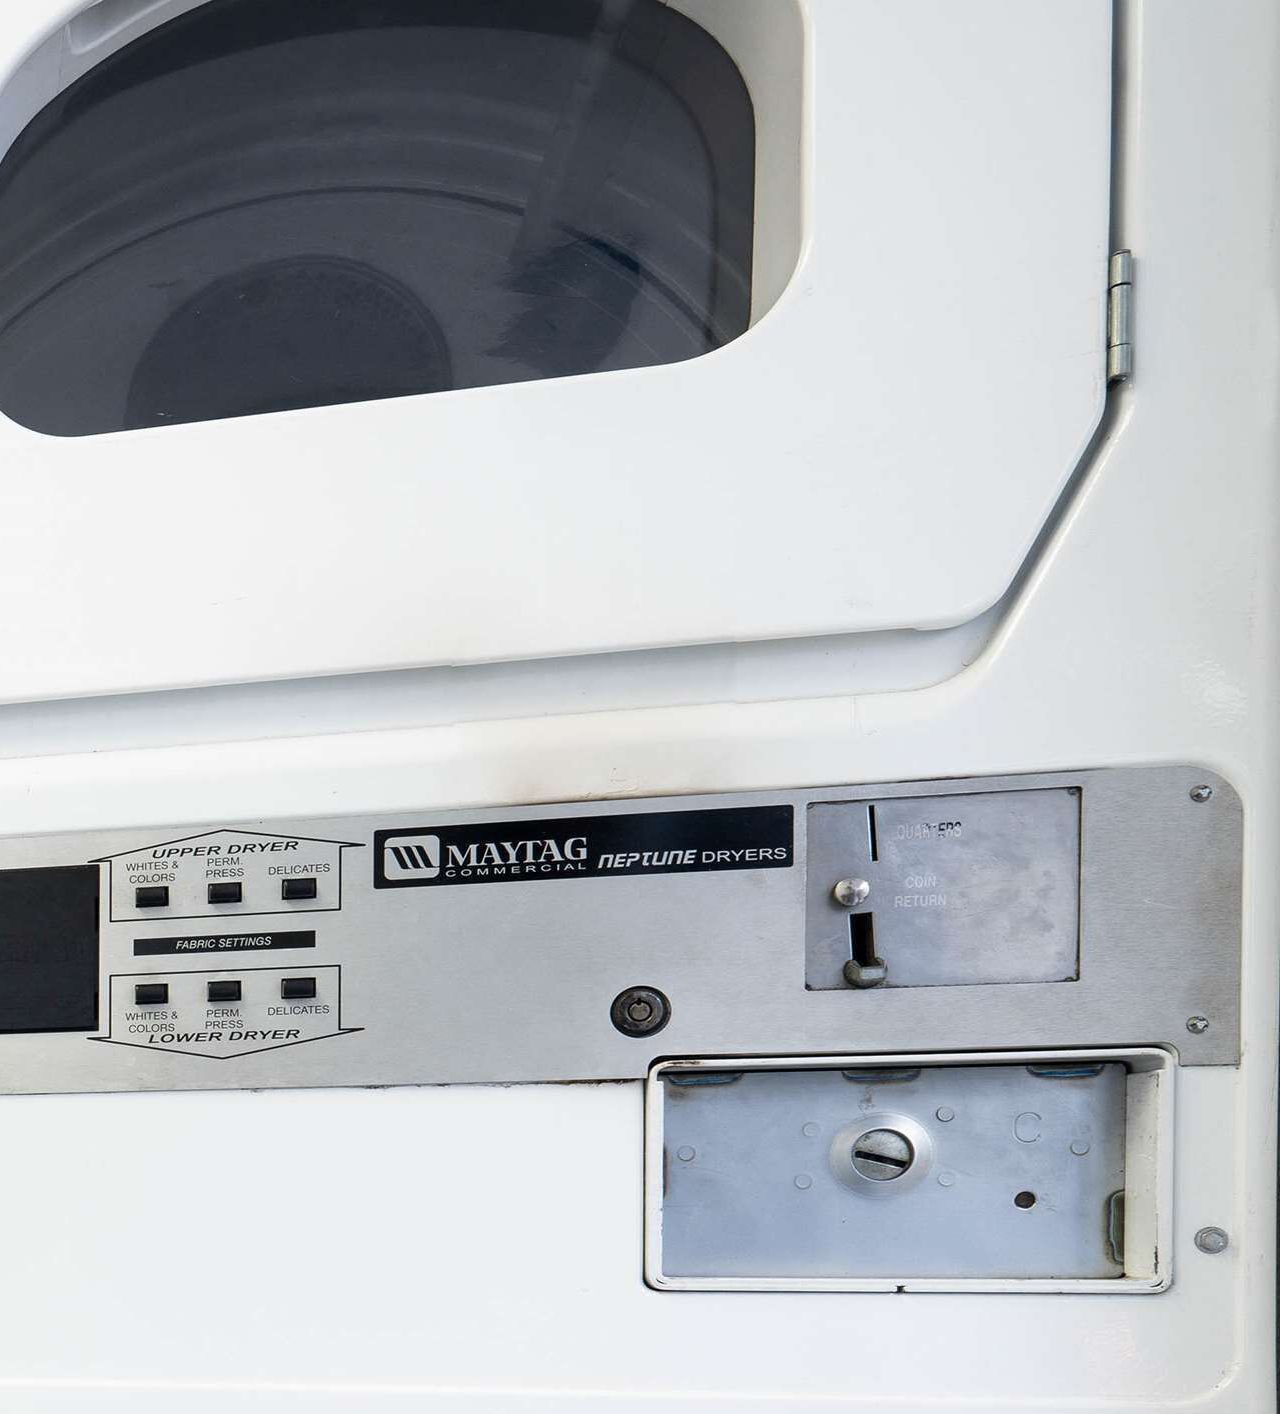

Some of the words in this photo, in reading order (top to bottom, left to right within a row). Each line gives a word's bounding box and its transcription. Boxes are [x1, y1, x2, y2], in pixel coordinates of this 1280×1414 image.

[152, 845, 221, 859] UPPER
[227, 841, 299, 856] DRYER
[445, 837, 588, 868] MAYTAG
[206, 857, 243, 868] PERM.
[598, 849, 698, 869] NEPTUNE
[701, 847, 788, 863] DRYERS
[125, 861, 169, 872] WHITES
[171, 861, 179, 870] &
[205, 867, 245, 878] PRESS
[268, 863, 331, 876] DELICATES
[445, 862, 587, 878] COMMERCIAL
[129, 873, 176, 884] COLORS
[905, 875, 937, 888] COIN
[894, 894, 946, 908] RETURN
[175, 938, 216, 950] FABRIC
[218, 936, 272, 948] SETTINGS
[125, 1011, 168, 1022] WHITES
[170, 1011, 178, 1020] &
[206, 1008, 242, 1019] PERM.
[267, 1005, 330, 1017] DELICATES
[128, 1023, 175, 1034] COLORS
[205, 1019, 244, 1030] PRESS
[148, 1031, 221, 1044] LOWER
[228, 1029, 301, 1042] DRYER
